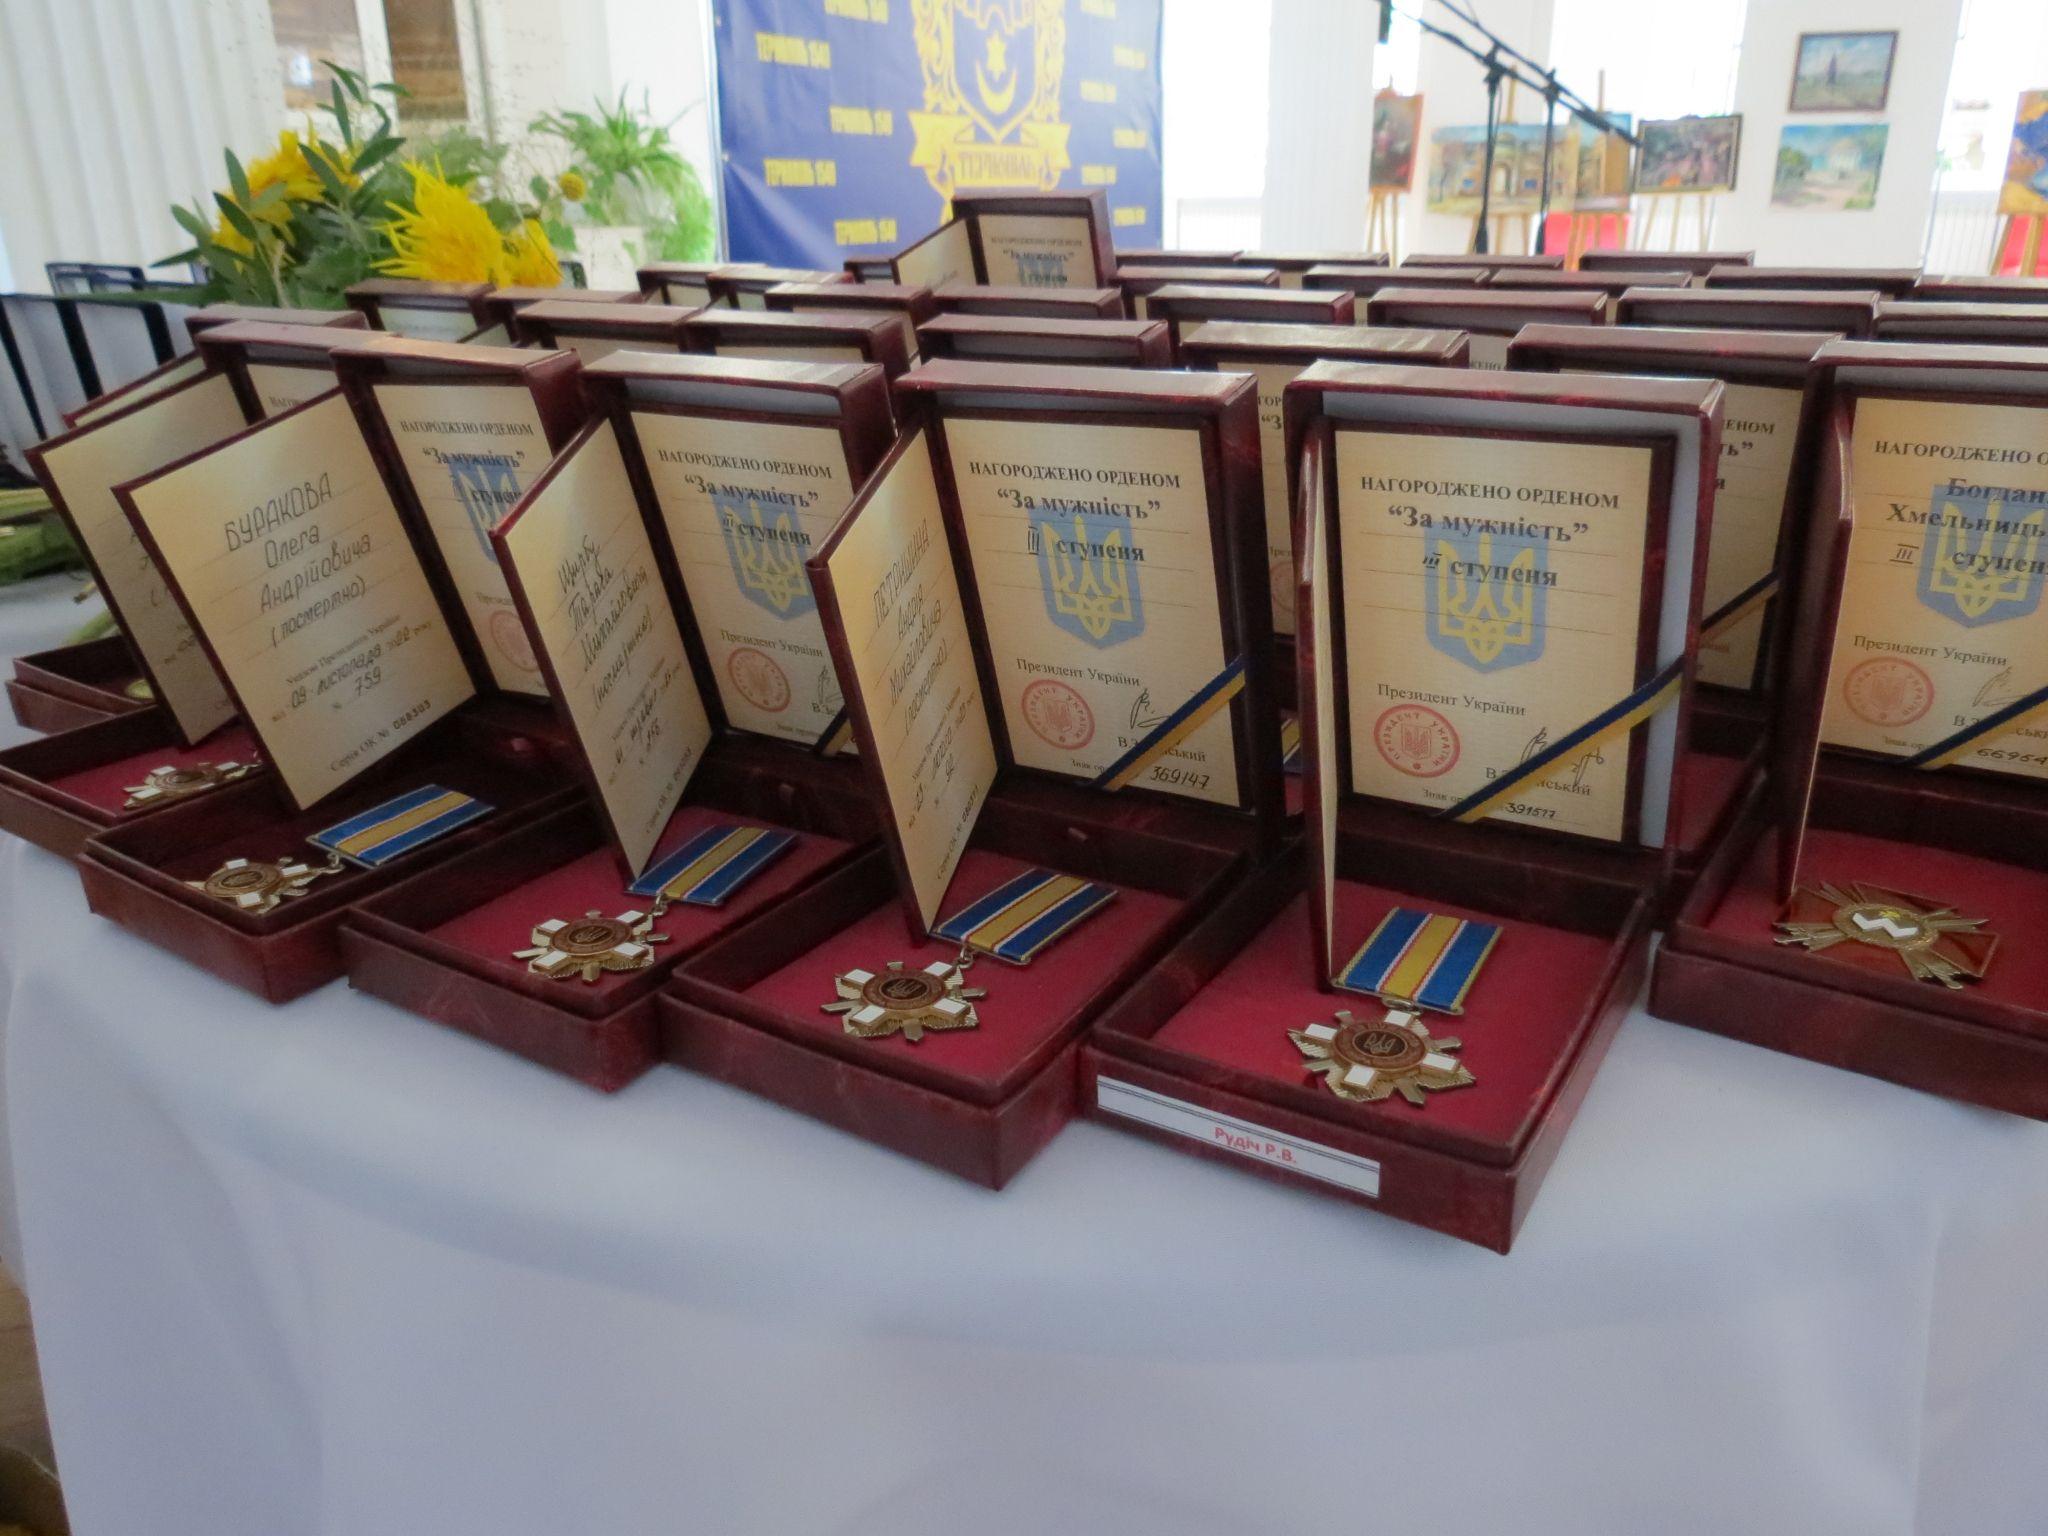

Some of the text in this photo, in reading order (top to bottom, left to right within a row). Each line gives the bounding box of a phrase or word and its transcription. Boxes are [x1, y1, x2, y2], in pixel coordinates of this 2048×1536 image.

[480, 422, 534, 436] ОРДЕНОМ
[658, 449, 832, 479] НАГОРОДЖЕНО ОРДЕНОМ
[1874, 440, 2031, 465] НАГОРОДЖЕНО
[969, 461, 1181, 488] НАГОРОДЖЕНО ОРДЕНОМ
[685, 475, 819, 508] “За мужність”
[997, 488, 1160, 520] “За мужність”
[1360, 476, 1620, 509] НАГОРОДЖЕНО ОРДЕНОМ
[1946, 477, 2048, 504] Богдан
[225, 472, 332, 552] БУРАКОВА
[1388, 504, 1589, 543] “За мужність”
[1887, 502, 2047, 538] Хмельниць
[264, 525, 320, 568] Олега
[738, 523, 811, 545] ступеня
[1056, 538, 1145, 562] ступеня
[1952, 548, 2048, 576] ступен
[260, 534, 371, 614] Андрійовича
[1450, 560, 1559, 586] ступеня
[720, 628, 823, 657] Президент України
[1853, 635, 2008, 667] Президент України
[1016, 658, 1141, 687] Президент України
[1377, 683, 1528, 716] Президент України
[1214, 1127, 1297, 1163] Рудіч Р.В.
